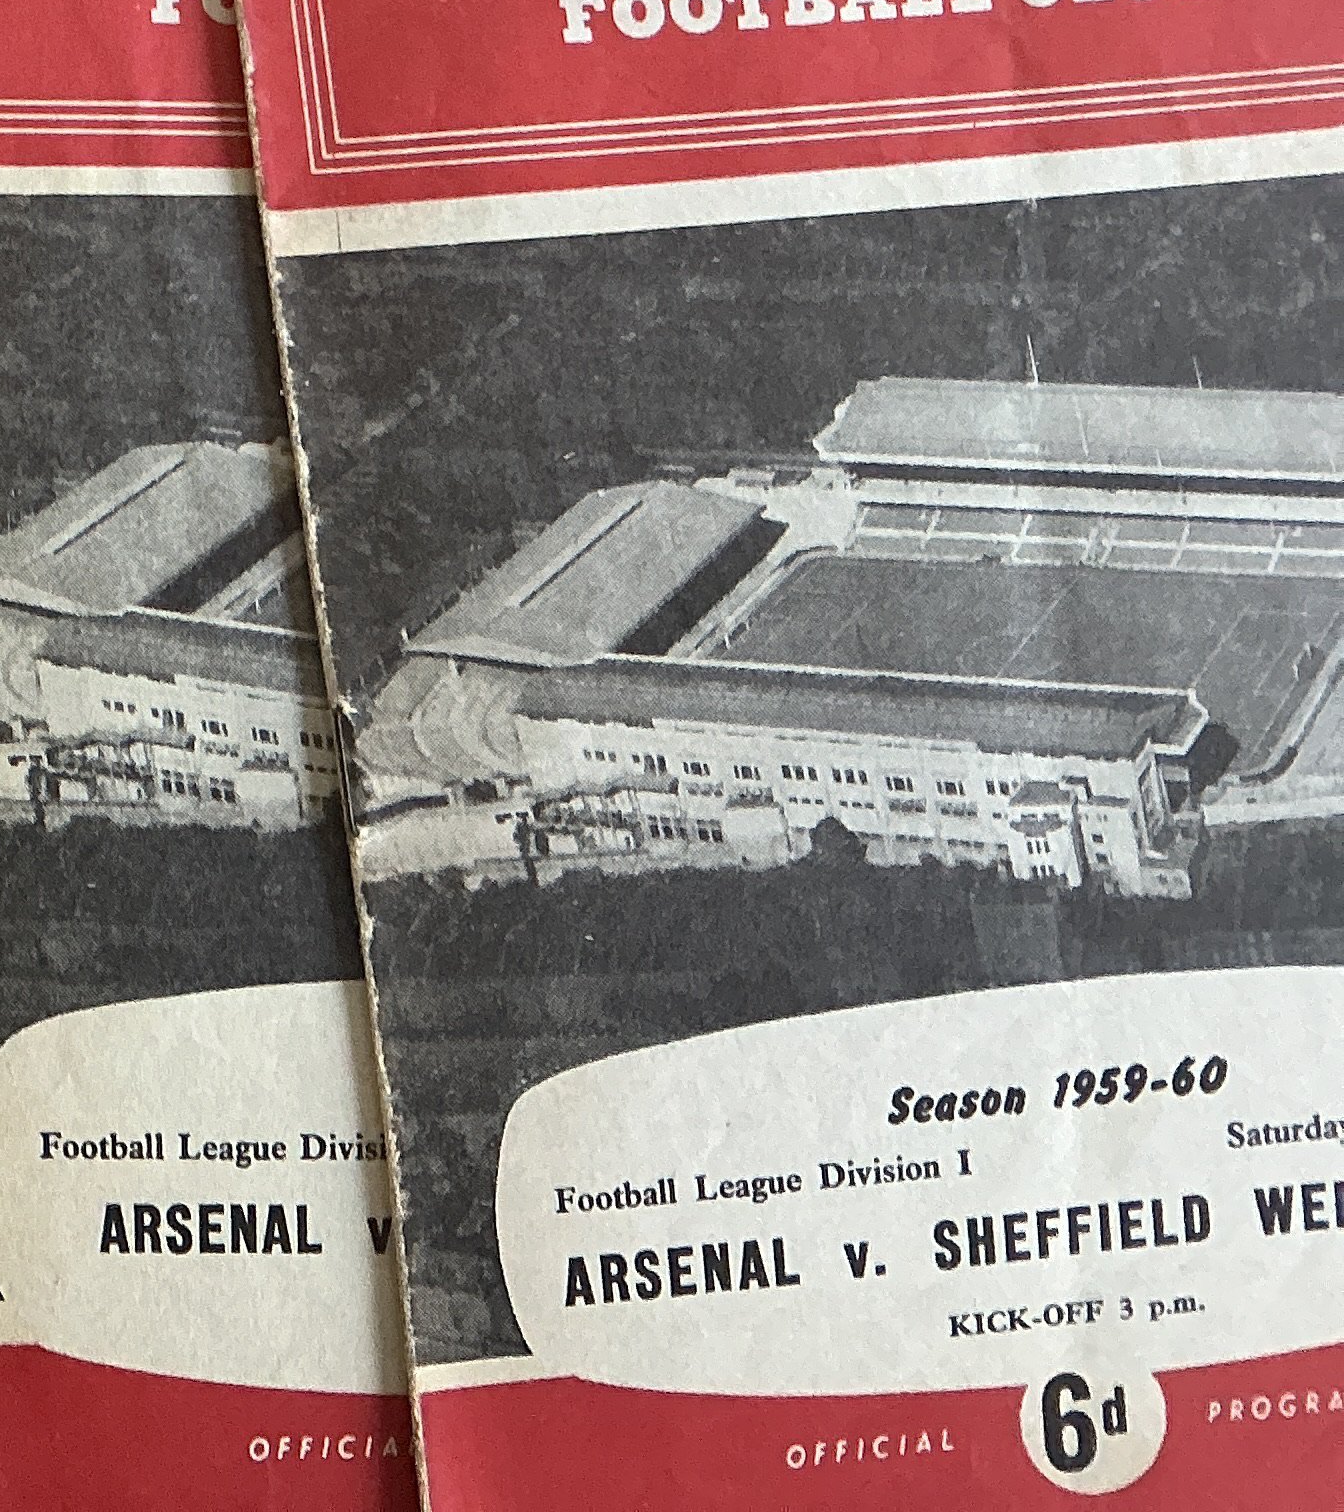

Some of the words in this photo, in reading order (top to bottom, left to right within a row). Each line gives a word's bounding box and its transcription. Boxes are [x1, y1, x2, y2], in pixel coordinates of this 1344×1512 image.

[887, 1085, 1027, 1125] Season
[1052, 1054, 1230, 1109] 1959-60
[39, 1131, 165, 1161] Football
[178, 1132, 288, 1169] League
[554, 1177, 678, 1215] Football
[695, 1171, 803, 1204] League
[818, 1154, 941, 1190] Division
[957, 1148, 972, 1177] I
[99, 1203, 323, 1256] ARSENAL
[564, 1236, 802, 1308] ARSENAL
[843, 1240, 888, 1279] v.
[932, 1193, 1212, 1271] SHEFFIELD
[948, 1299, 1104, 1338] KICK-OFF
[1118, 1296, 1134, 1321] 3
[1148, 1294, 1206, 1323] p.m.
[785, 1427, 955, 1470] OFFICIAL
[1040, 1371, 1129, 1475] 6d
